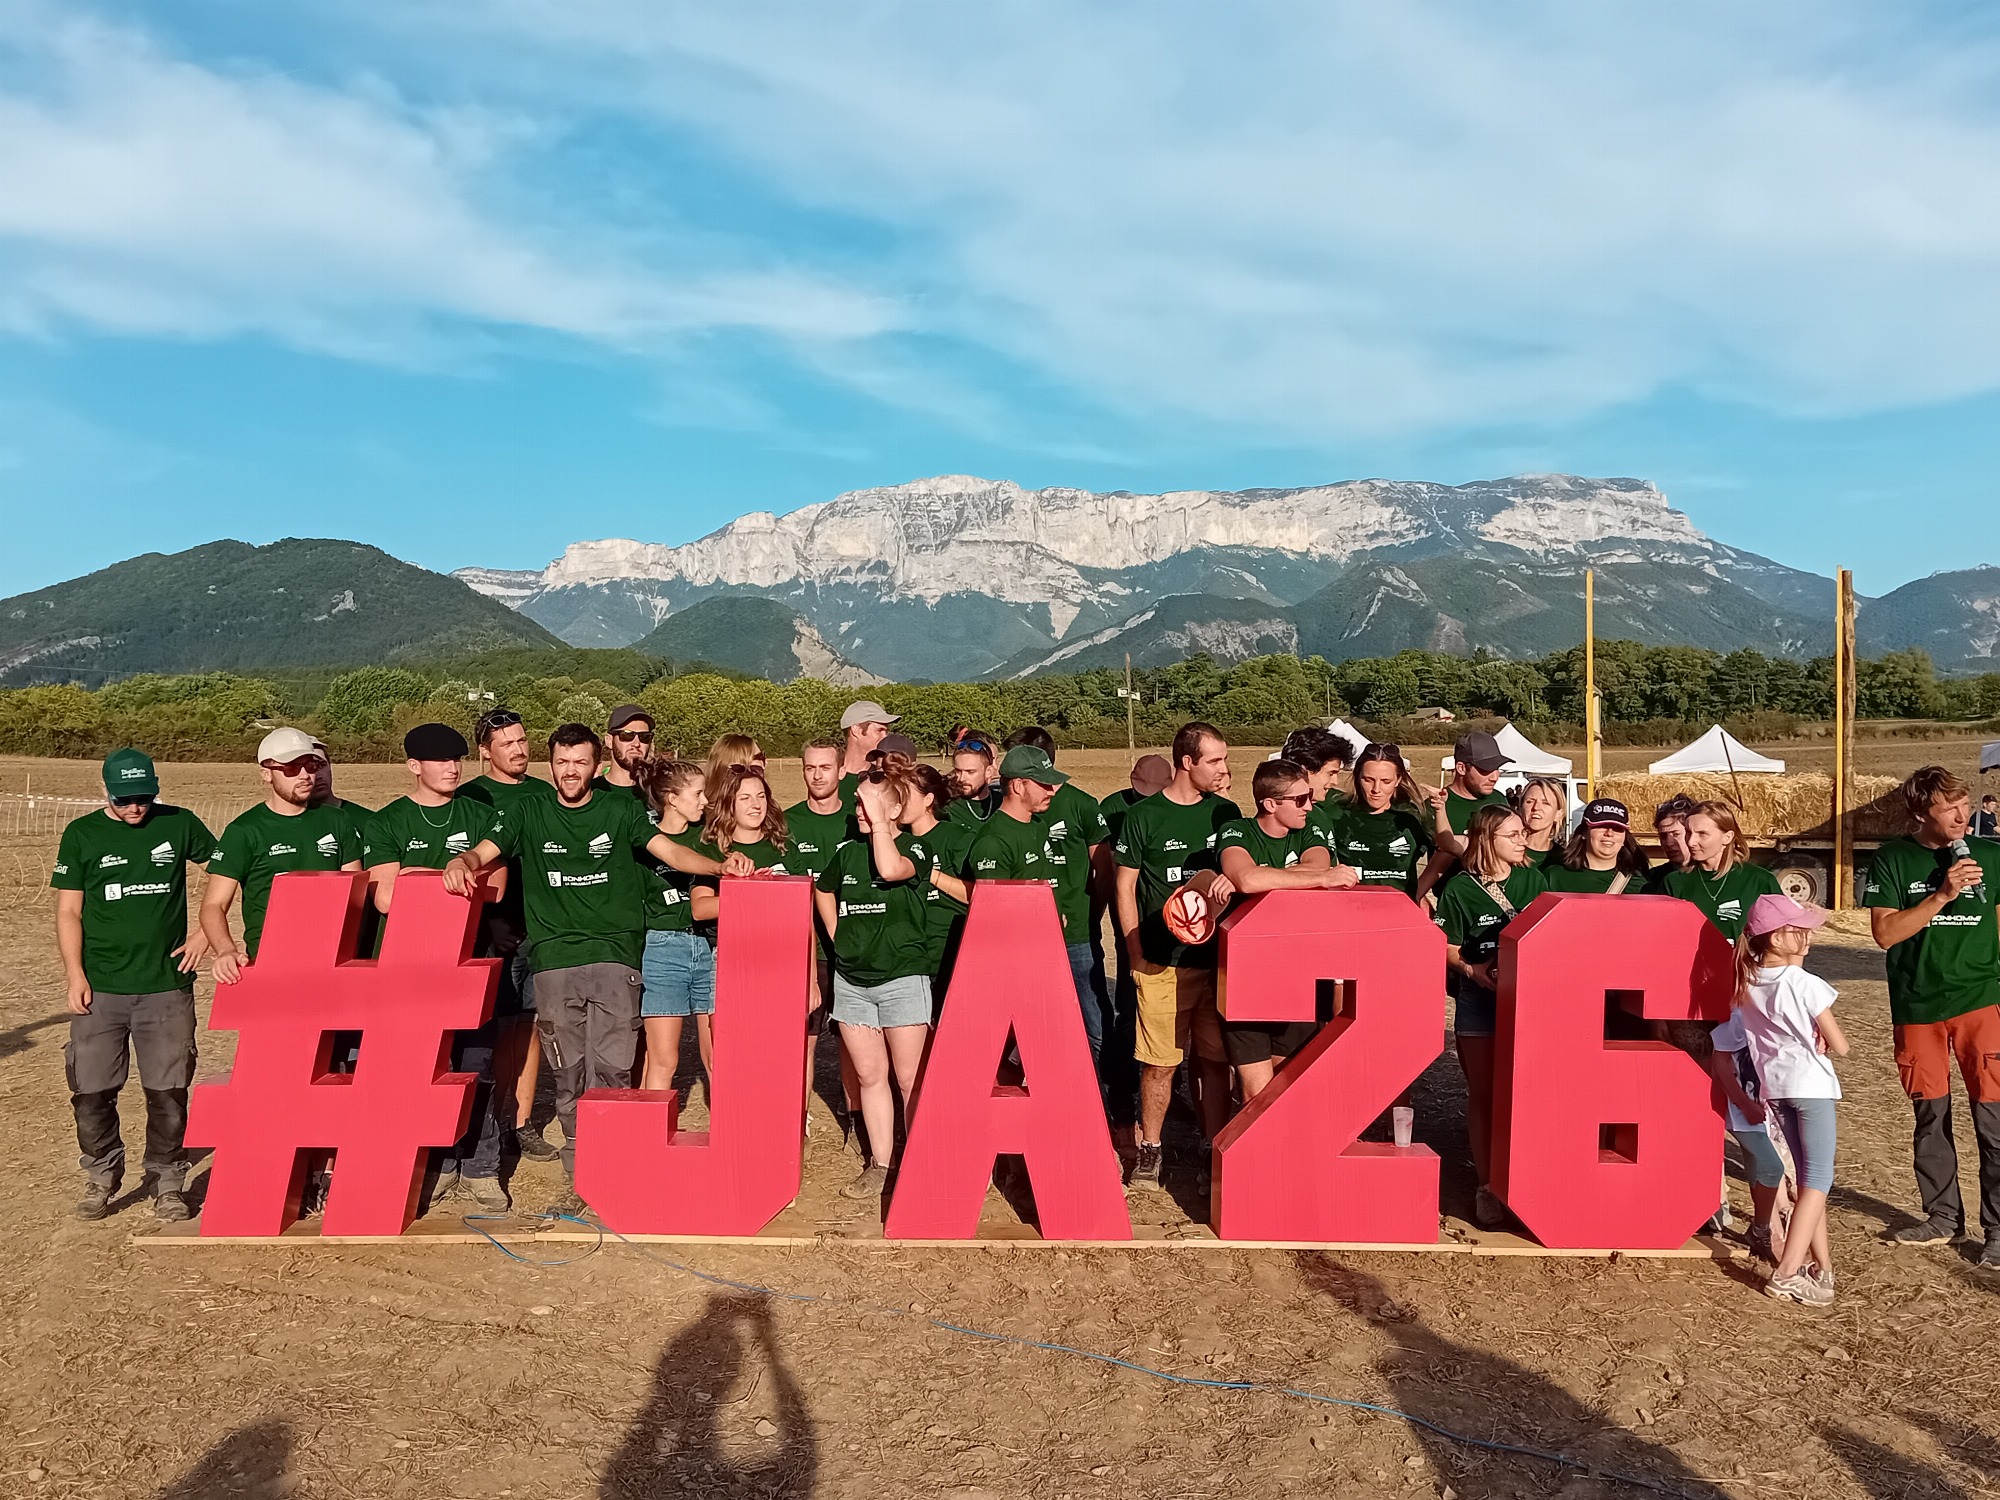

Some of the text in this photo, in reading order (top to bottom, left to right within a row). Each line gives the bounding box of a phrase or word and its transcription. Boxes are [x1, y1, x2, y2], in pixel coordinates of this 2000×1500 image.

[562, 871, 608, 882] BONHOMME
[847, 903, 886, 911] BONHOMME
[185, 873, 1734, 1249] #JA26
